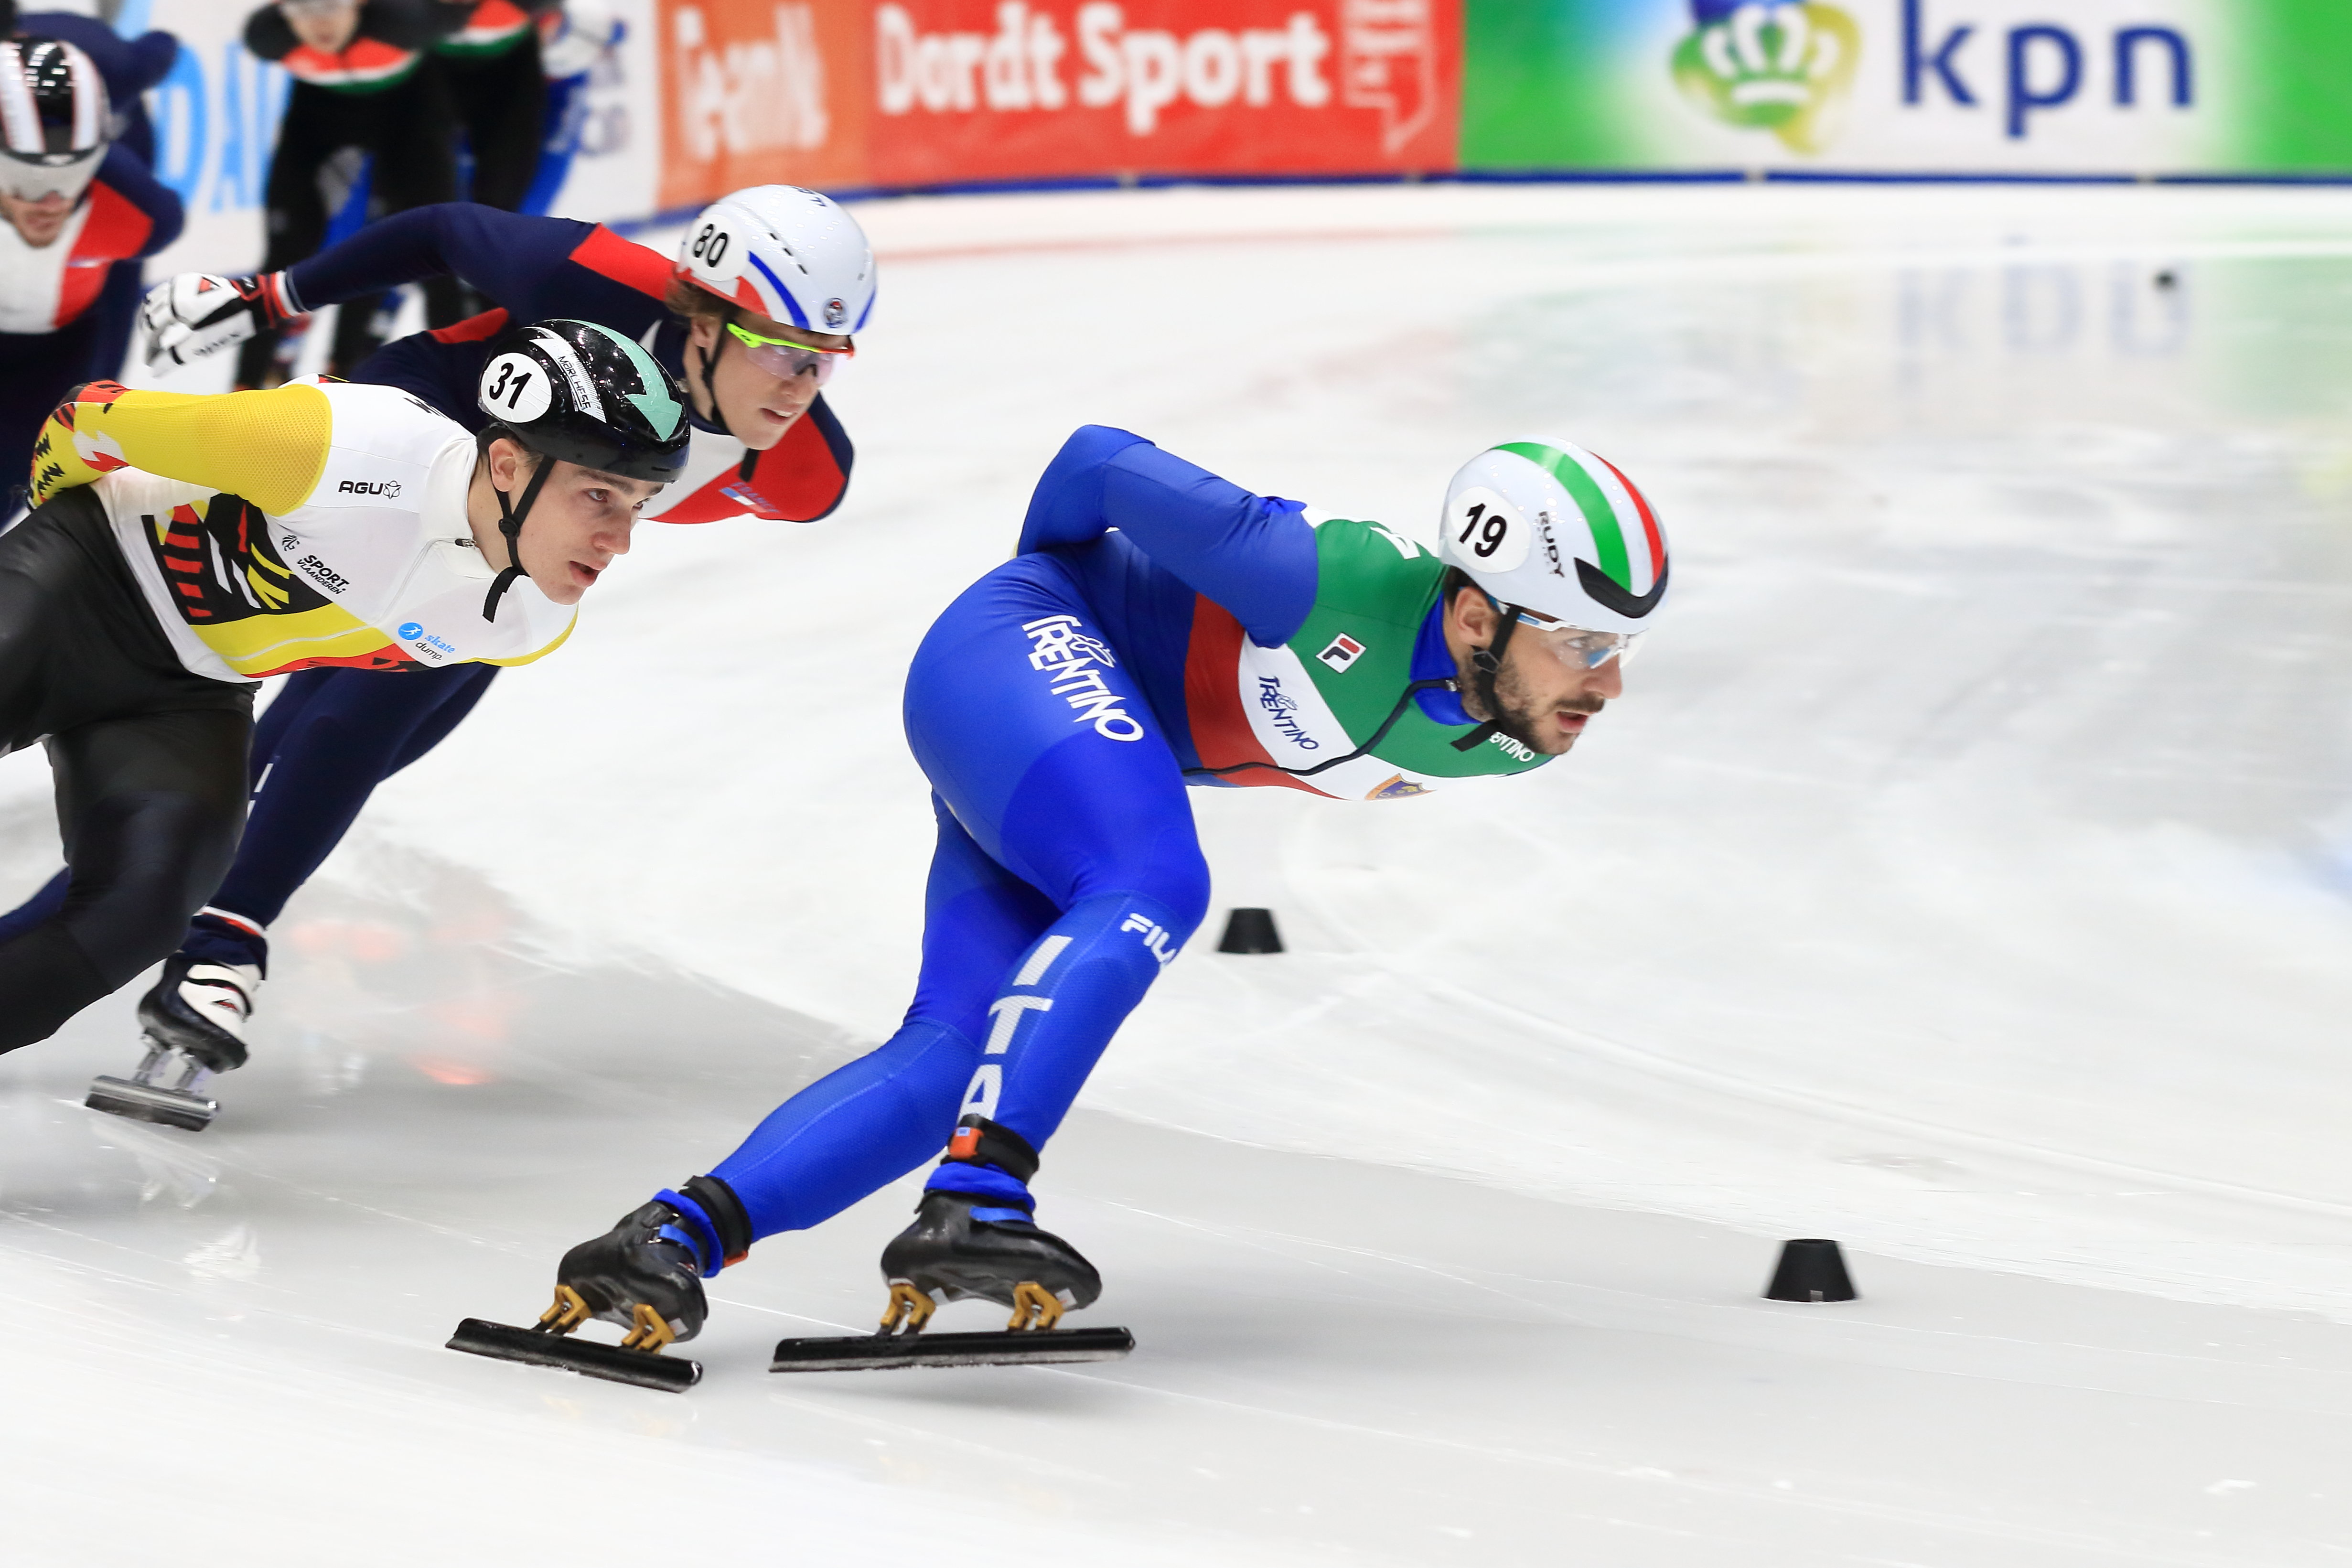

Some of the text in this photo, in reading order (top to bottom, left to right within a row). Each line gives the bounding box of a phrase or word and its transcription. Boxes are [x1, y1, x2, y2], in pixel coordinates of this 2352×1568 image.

[877, 1, 1331, 134] Dordt Sport
[1901, 0, 2194, 138] kpn
[693, 223, 730, 268] 80
[489, 362, 533, 409] 31
[338, 481, 384, 495] AGU
[1459, 503, 1507, 558] 19
[1538, 511, 1565, 578] RUDY
[297, 559, 342, 594] VLAANDEREN
[424, 634, 456, 654] skate
[1021, 614, 1144, 742] TRENTINO
[1258, 676, 1320, 750] TRENTINO
[1488, 731, 1536, 763] ENTINO
[957, 934, 1074, 1127] ITA
